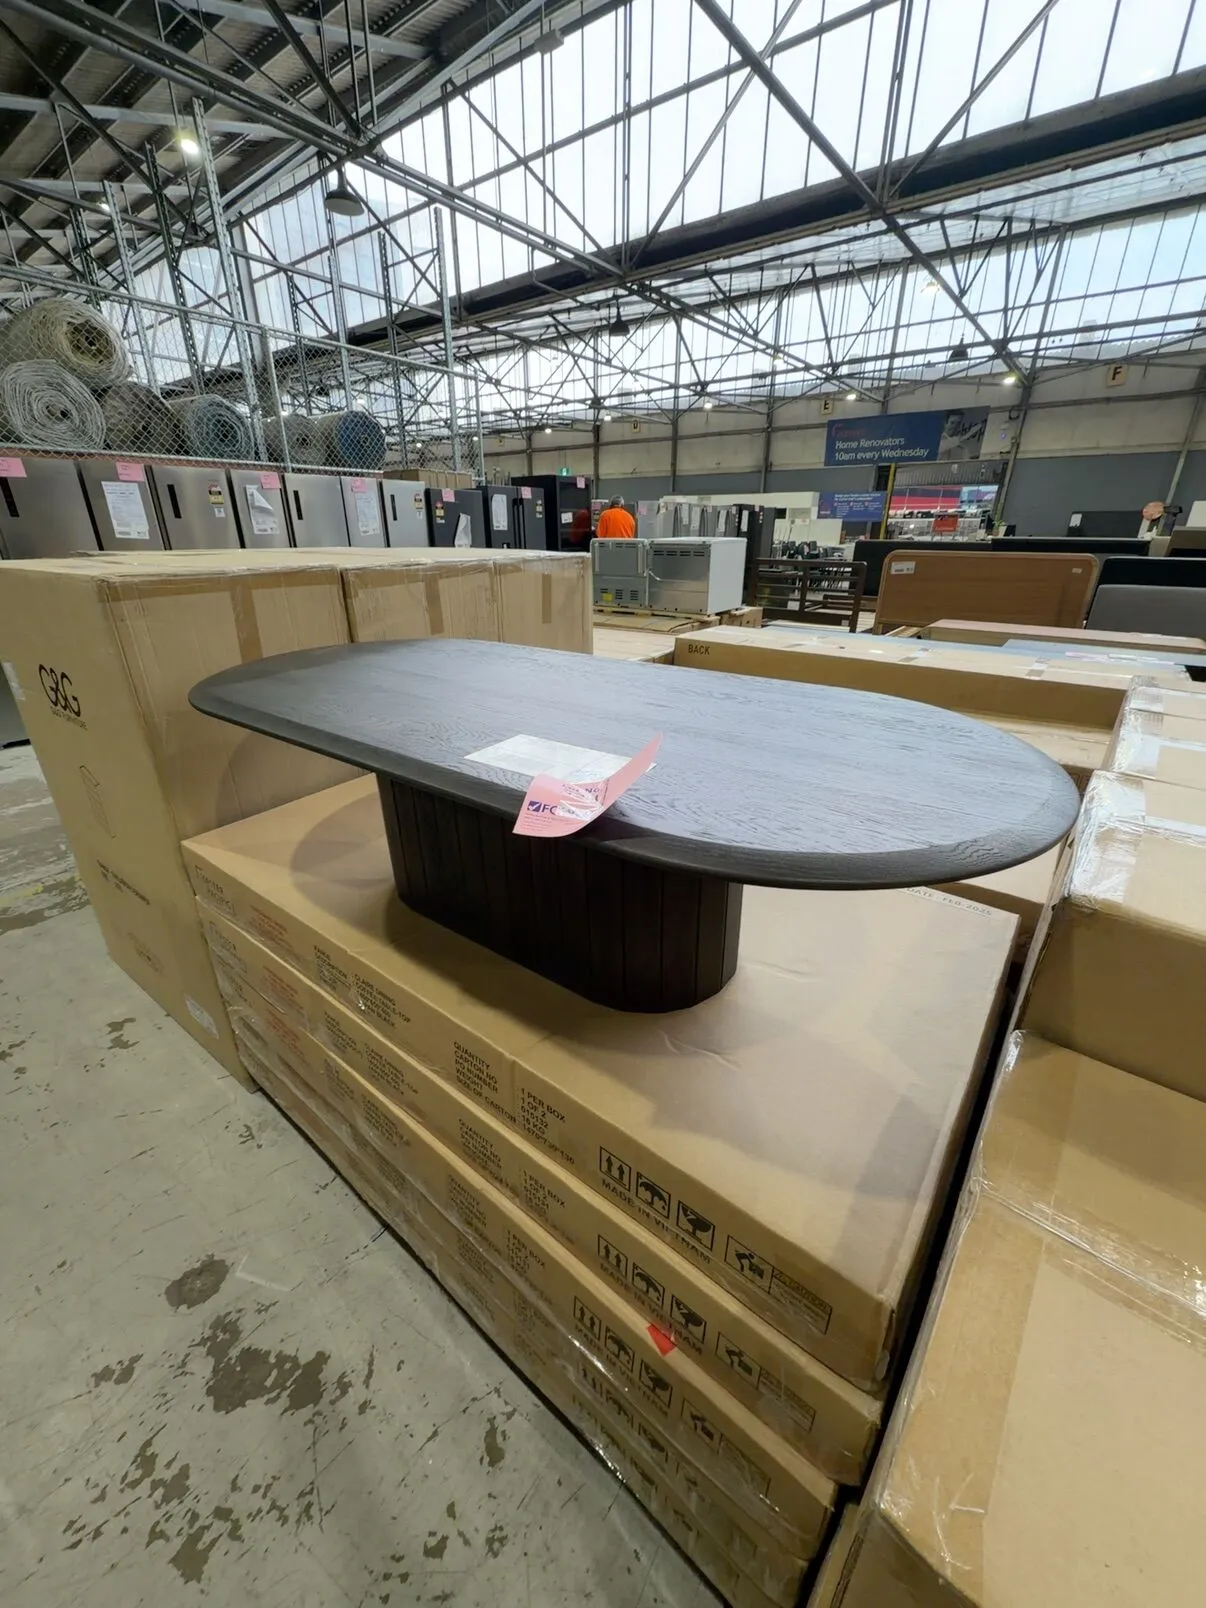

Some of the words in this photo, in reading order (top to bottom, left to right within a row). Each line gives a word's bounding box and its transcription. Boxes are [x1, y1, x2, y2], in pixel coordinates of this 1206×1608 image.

[1111, 365, 1122, 381] F
[823, 399, 830, 411] E
[835, 440, 859, 449] Home
[860, 437, 905, 448] Renovators
[835, 451, 856, 461] 10am
[857, 450, 880, 461] every
[882, 447, 930, 458] Wednesday
[688, 644, 711, 656] BACK
[453, 1042, 489, 1070] QUANTITY
[454, 1051, 484, 1074] CARTON
[527, 1093, 544, 1107] PER
[546, 1105, 565, 1122] BOX
[602, 1180, 634, 1207] MADE
[638, 1206, 649, 1219] IN
[654, 1218, 710, 1263] VIETNAM
